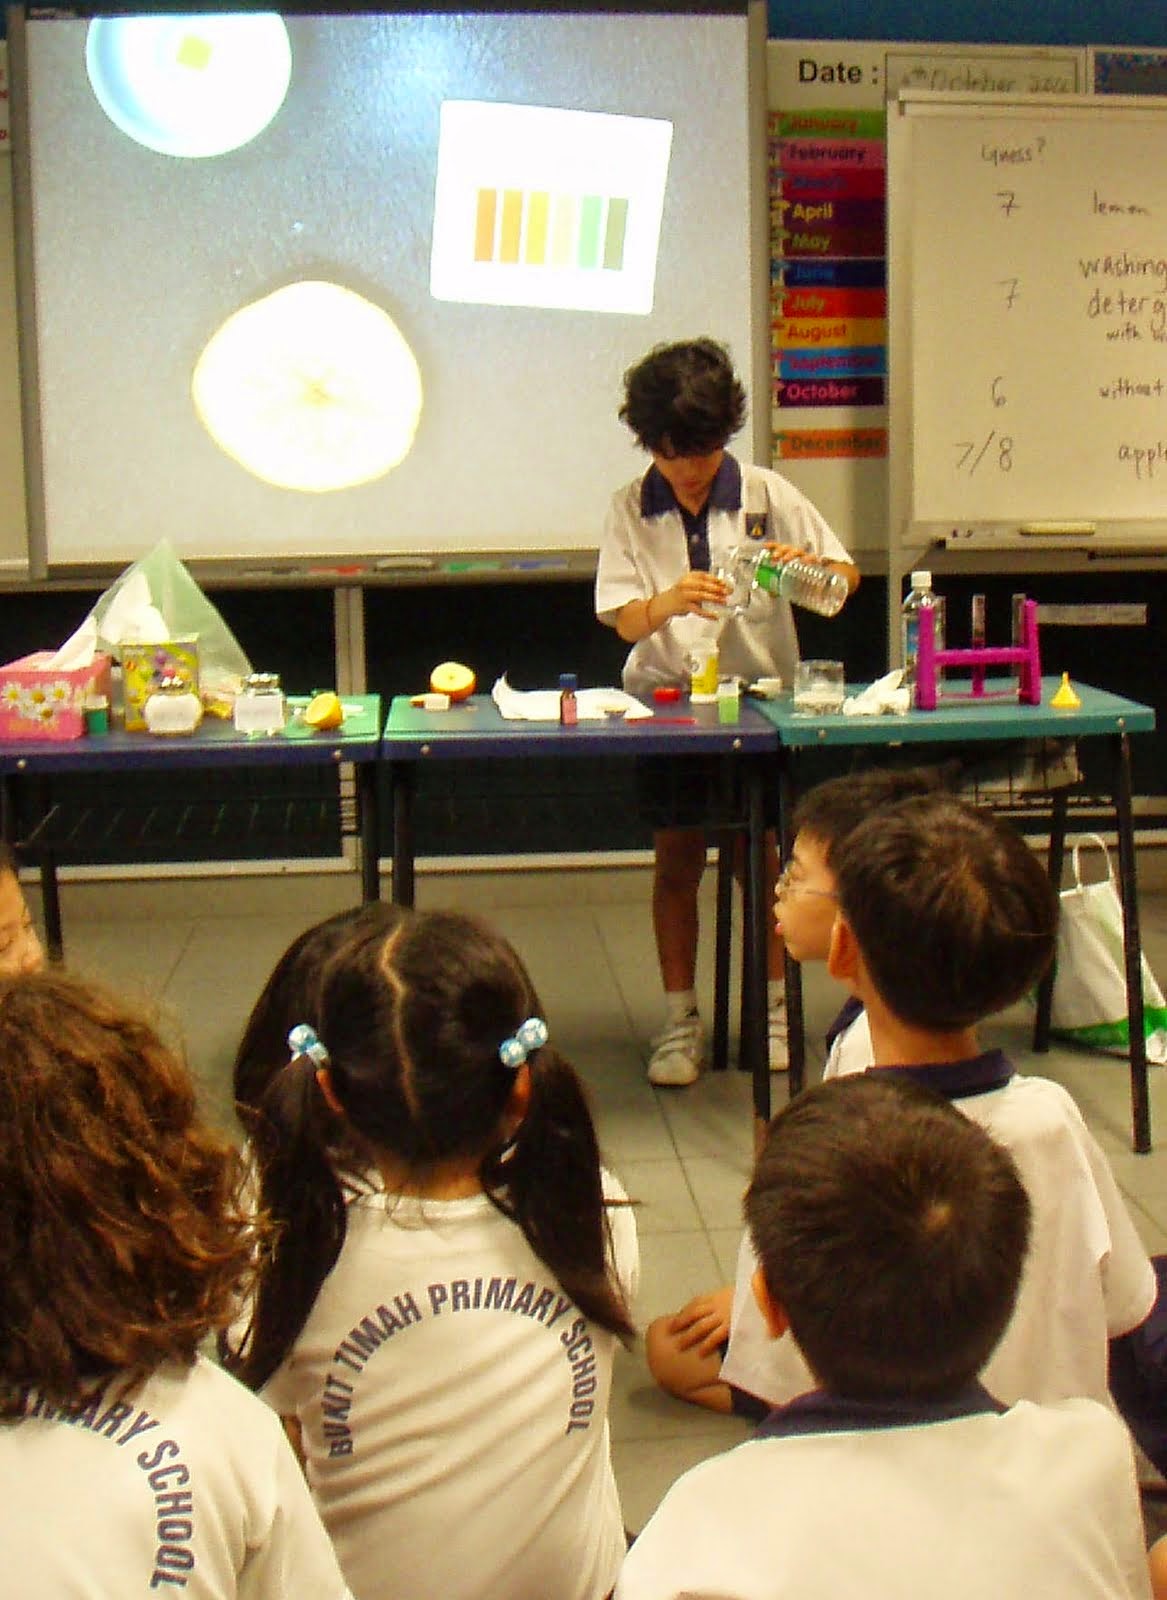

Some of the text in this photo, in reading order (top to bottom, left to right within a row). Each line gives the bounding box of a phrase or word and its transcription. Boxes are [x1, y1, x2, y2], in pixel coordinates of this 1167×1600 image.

[799, 60, 863, 84] Date
[788, 142, 867, 165] February
[792, 202, 833, 224] April
[997, 191, 1021, 217] 7
[1092, 189, 1150, 215] lemon
[791, 233, 832, 252] May
[998, 279, 1022, 309] 7
[786, 323, 847, 343] August
[1106, 321, 1141, 342] with
[786, 382, 858, 401] October
[320, 1277, 598, 1458] BUKIT TIMAH PRIMARY SCHOOL
[137, 1439, 195, 1588] SCHOOL
